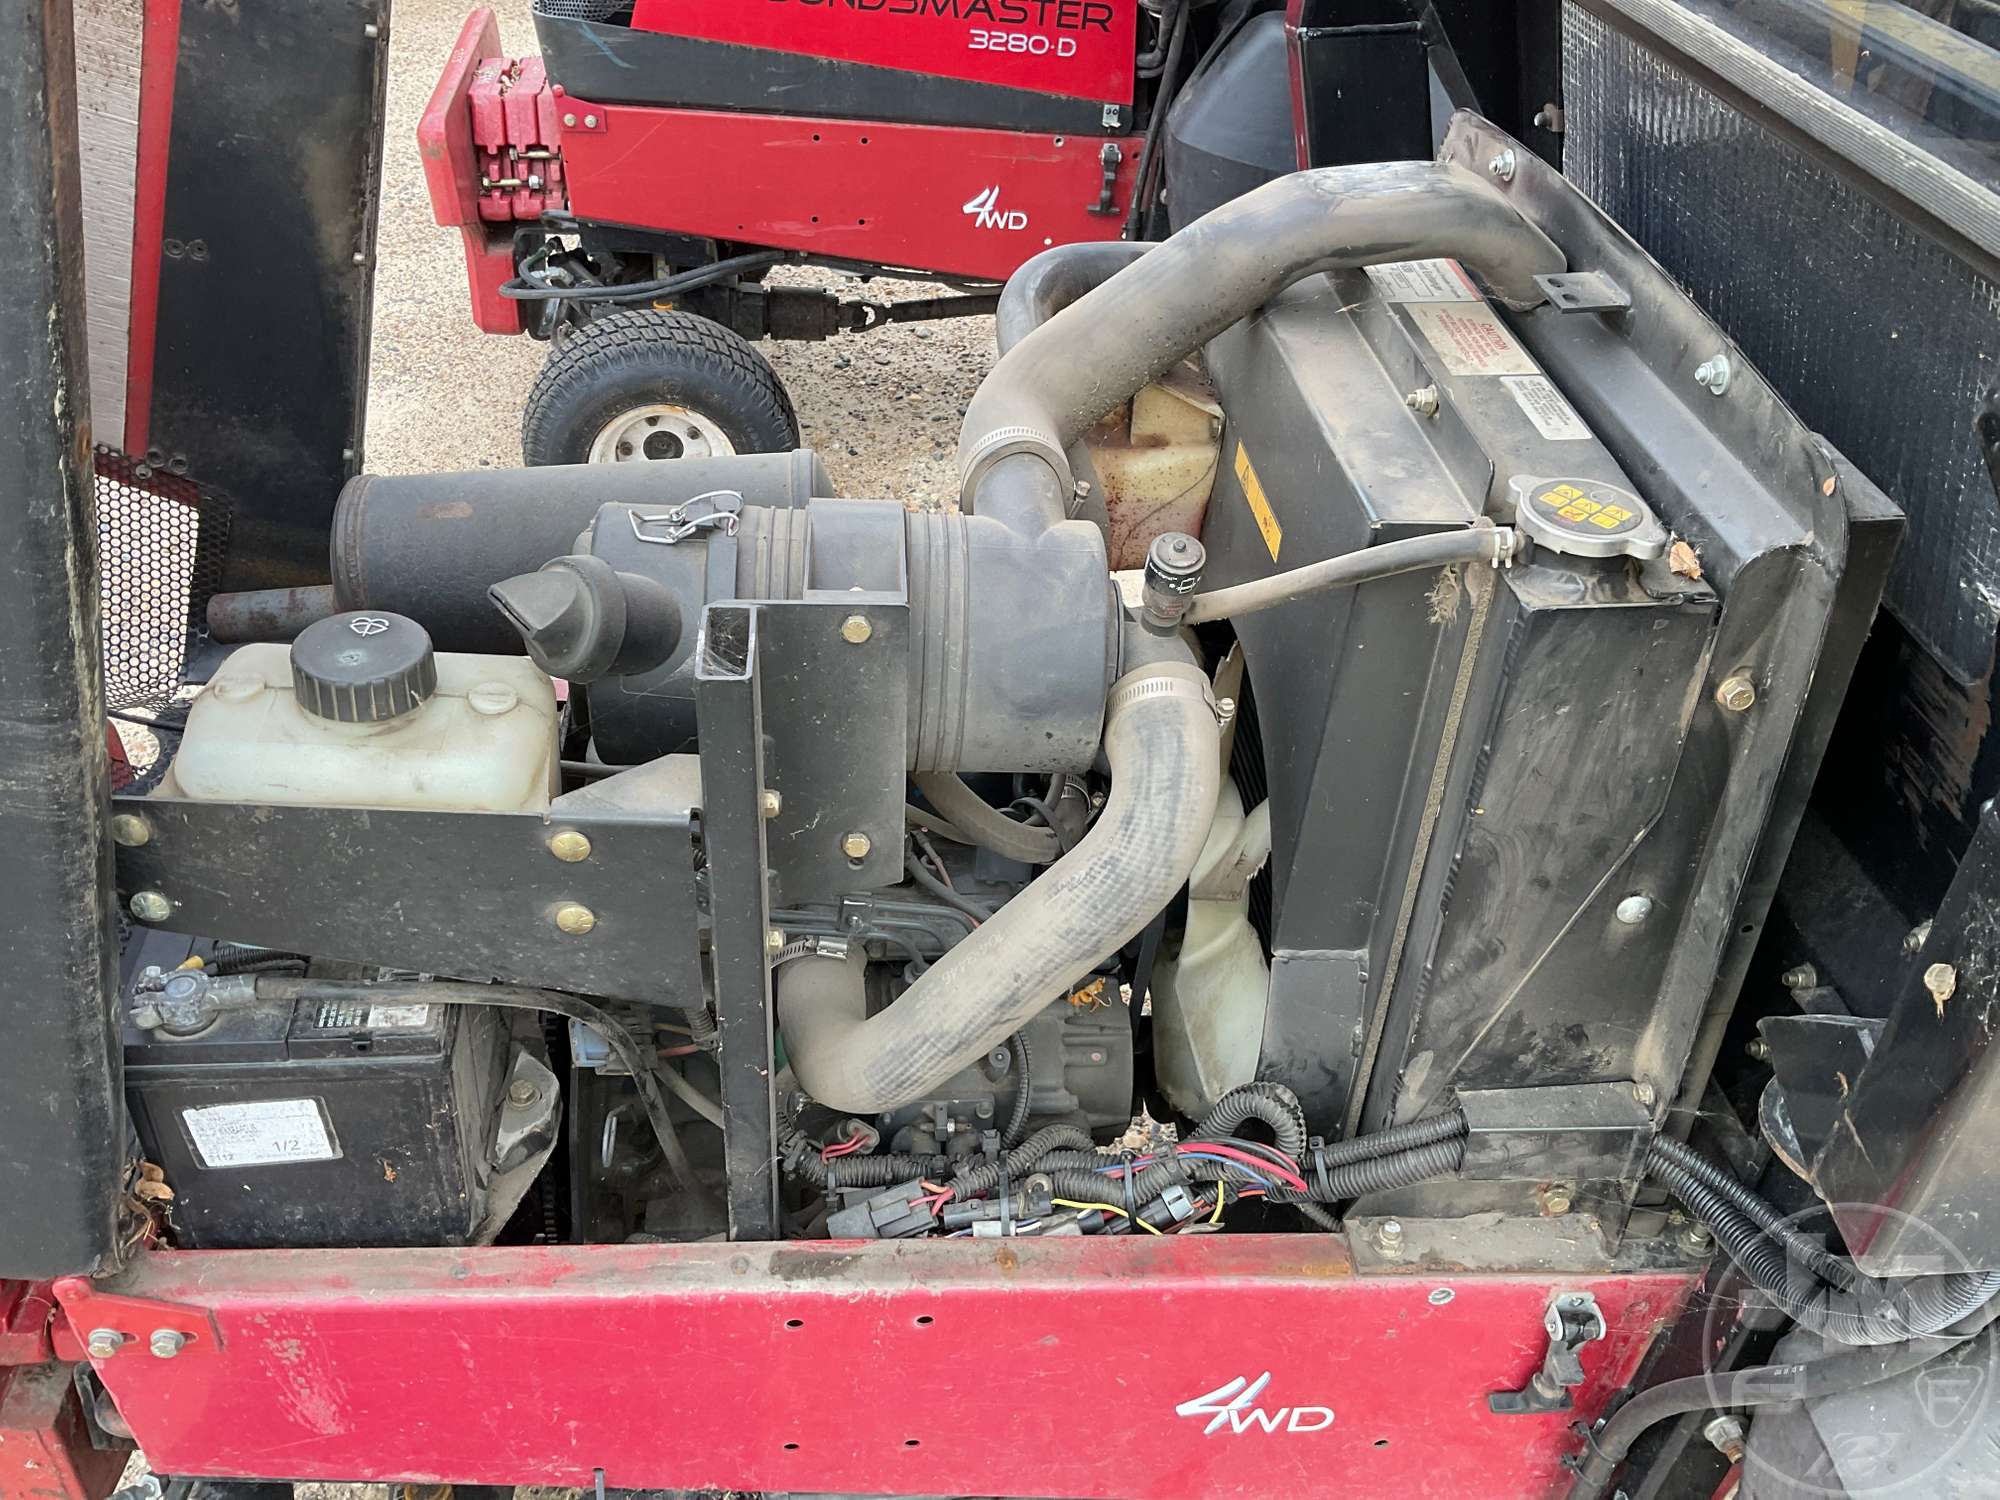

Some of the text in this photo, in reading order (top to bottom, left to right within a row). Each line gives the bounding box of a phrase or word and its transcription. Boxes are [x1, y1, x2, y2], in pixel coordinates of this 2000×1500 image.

[962, 184, 1028, 230] 4WD
[1480, 322, 1510, 351] CAUTION
[272, 1139, 302, 1153] 1/2
[1175, 1371, 1335, 1435] 4WD
